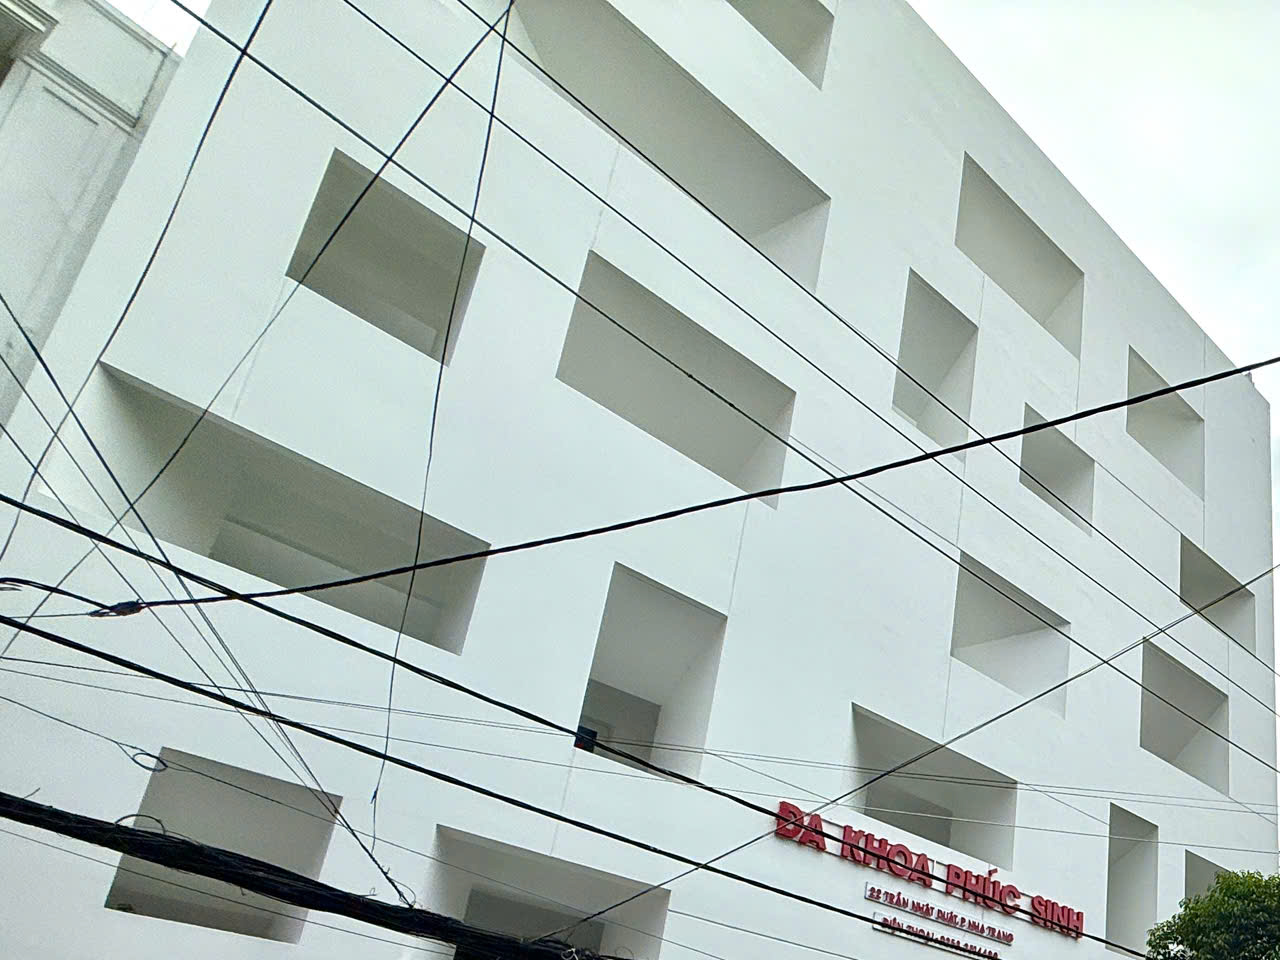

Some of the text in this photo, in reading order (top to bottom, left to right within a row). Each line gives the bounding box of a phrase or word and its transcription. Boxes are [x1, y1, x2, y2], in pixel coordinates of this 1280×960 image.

[841, 825, 932, 888] KHOA
[946, 864, 1021, 915] PHÚC
[1031, 895, 1084, 940] SINH
[868, 886, 882, 900] 22
[968, 919, 985, 935] NHA
[986, 926, 1014, 943] TRANG
